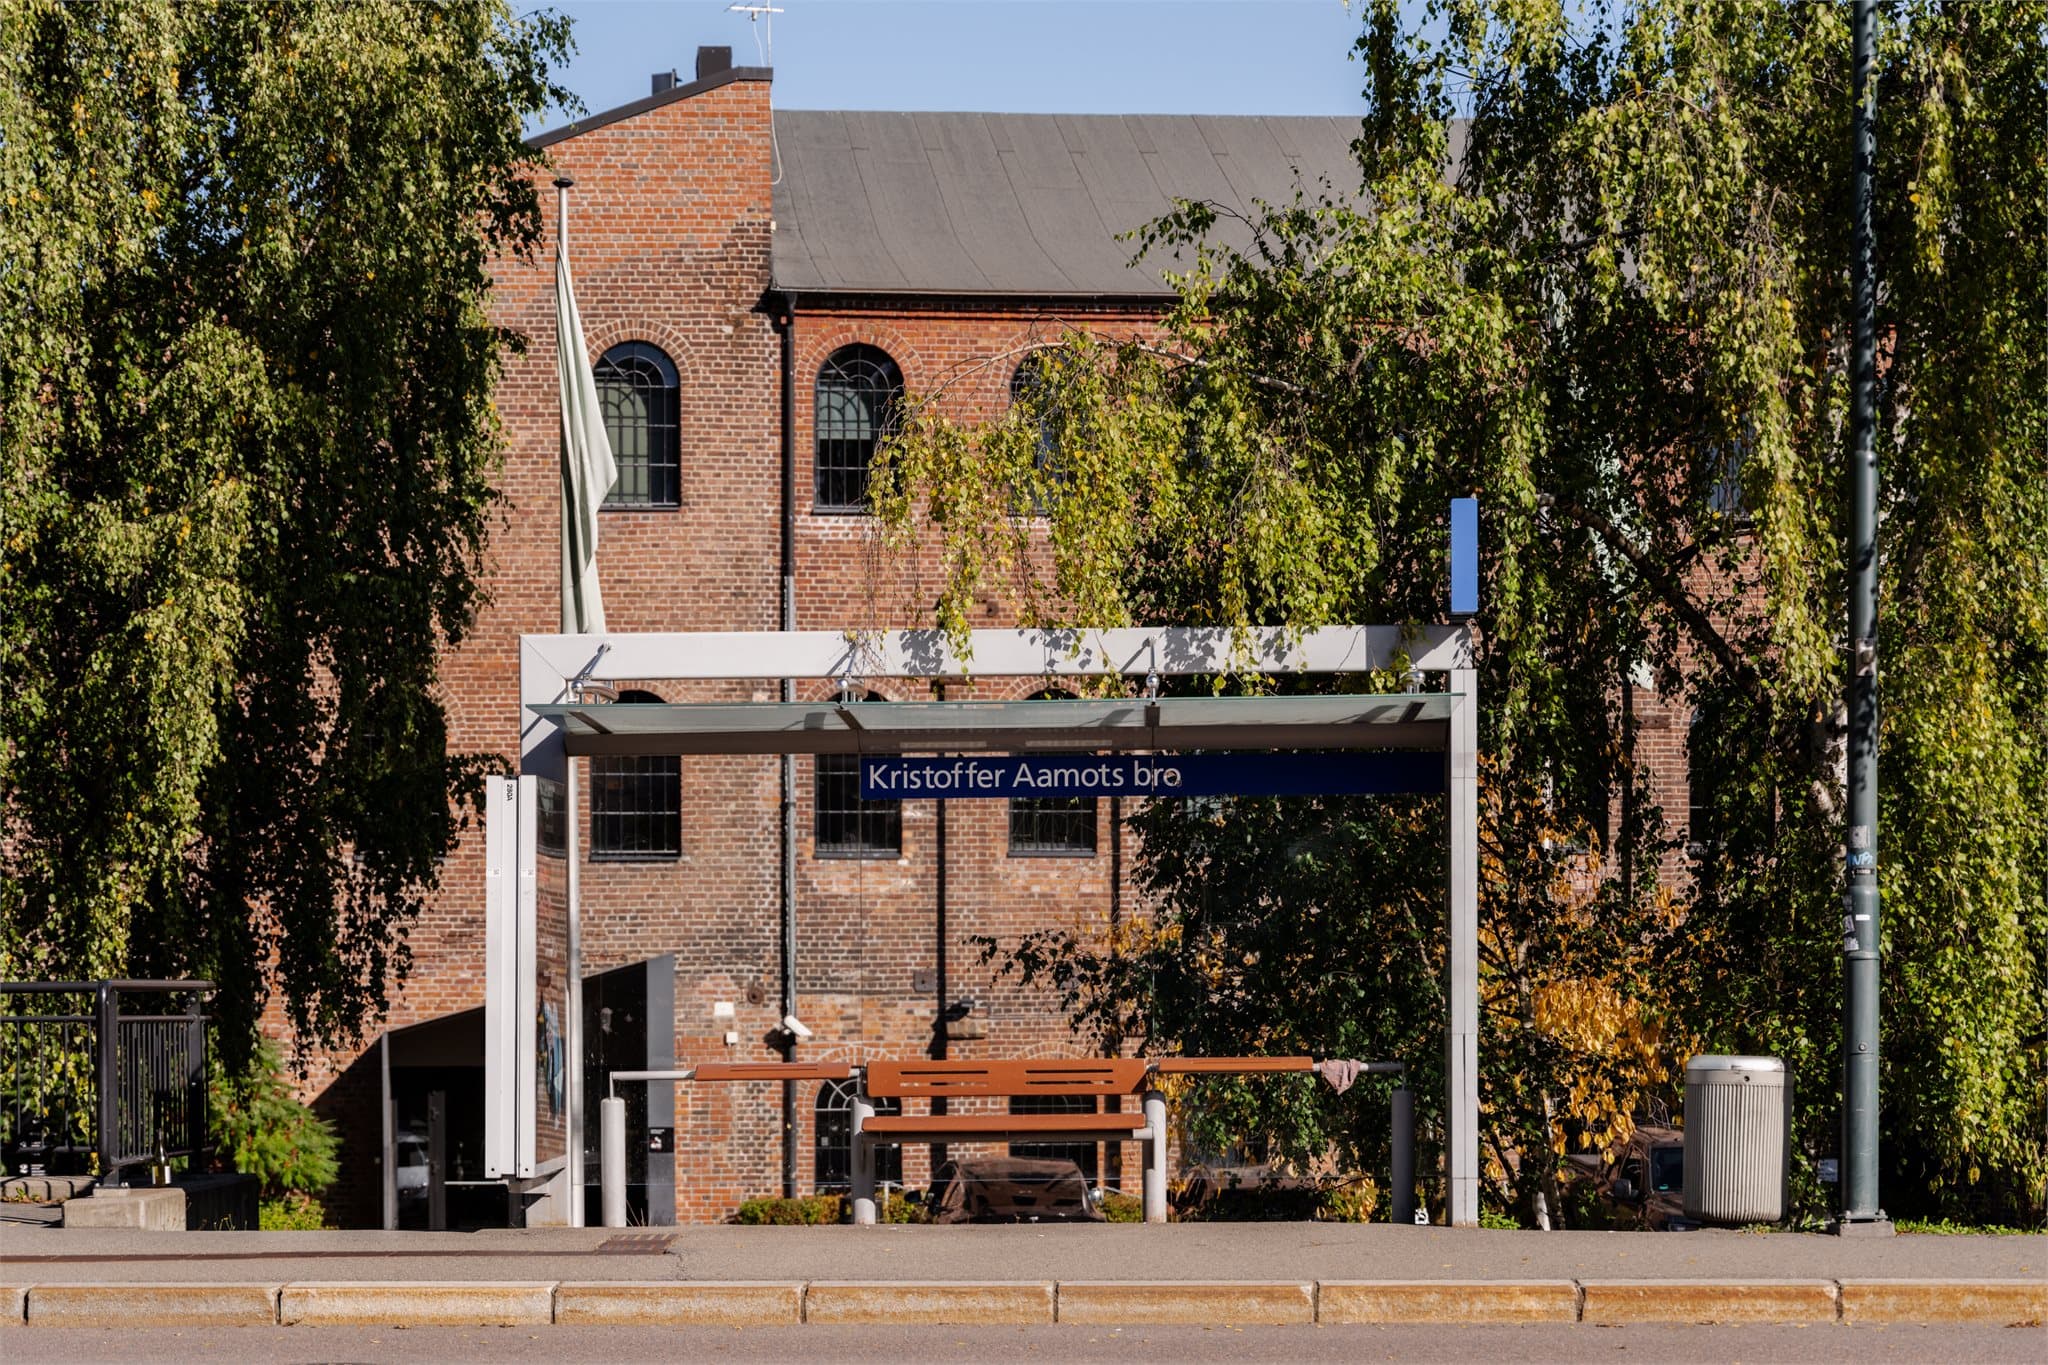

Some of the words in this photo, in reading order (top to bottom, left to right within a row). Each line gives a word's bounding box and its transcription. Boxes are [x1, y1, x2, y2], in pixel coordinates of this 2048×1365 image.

[870, 762, 1006, 789] Kristoffer
[1013, 764, 1124, 788] Aamots
[1134, 760, 1181, 787] bro
